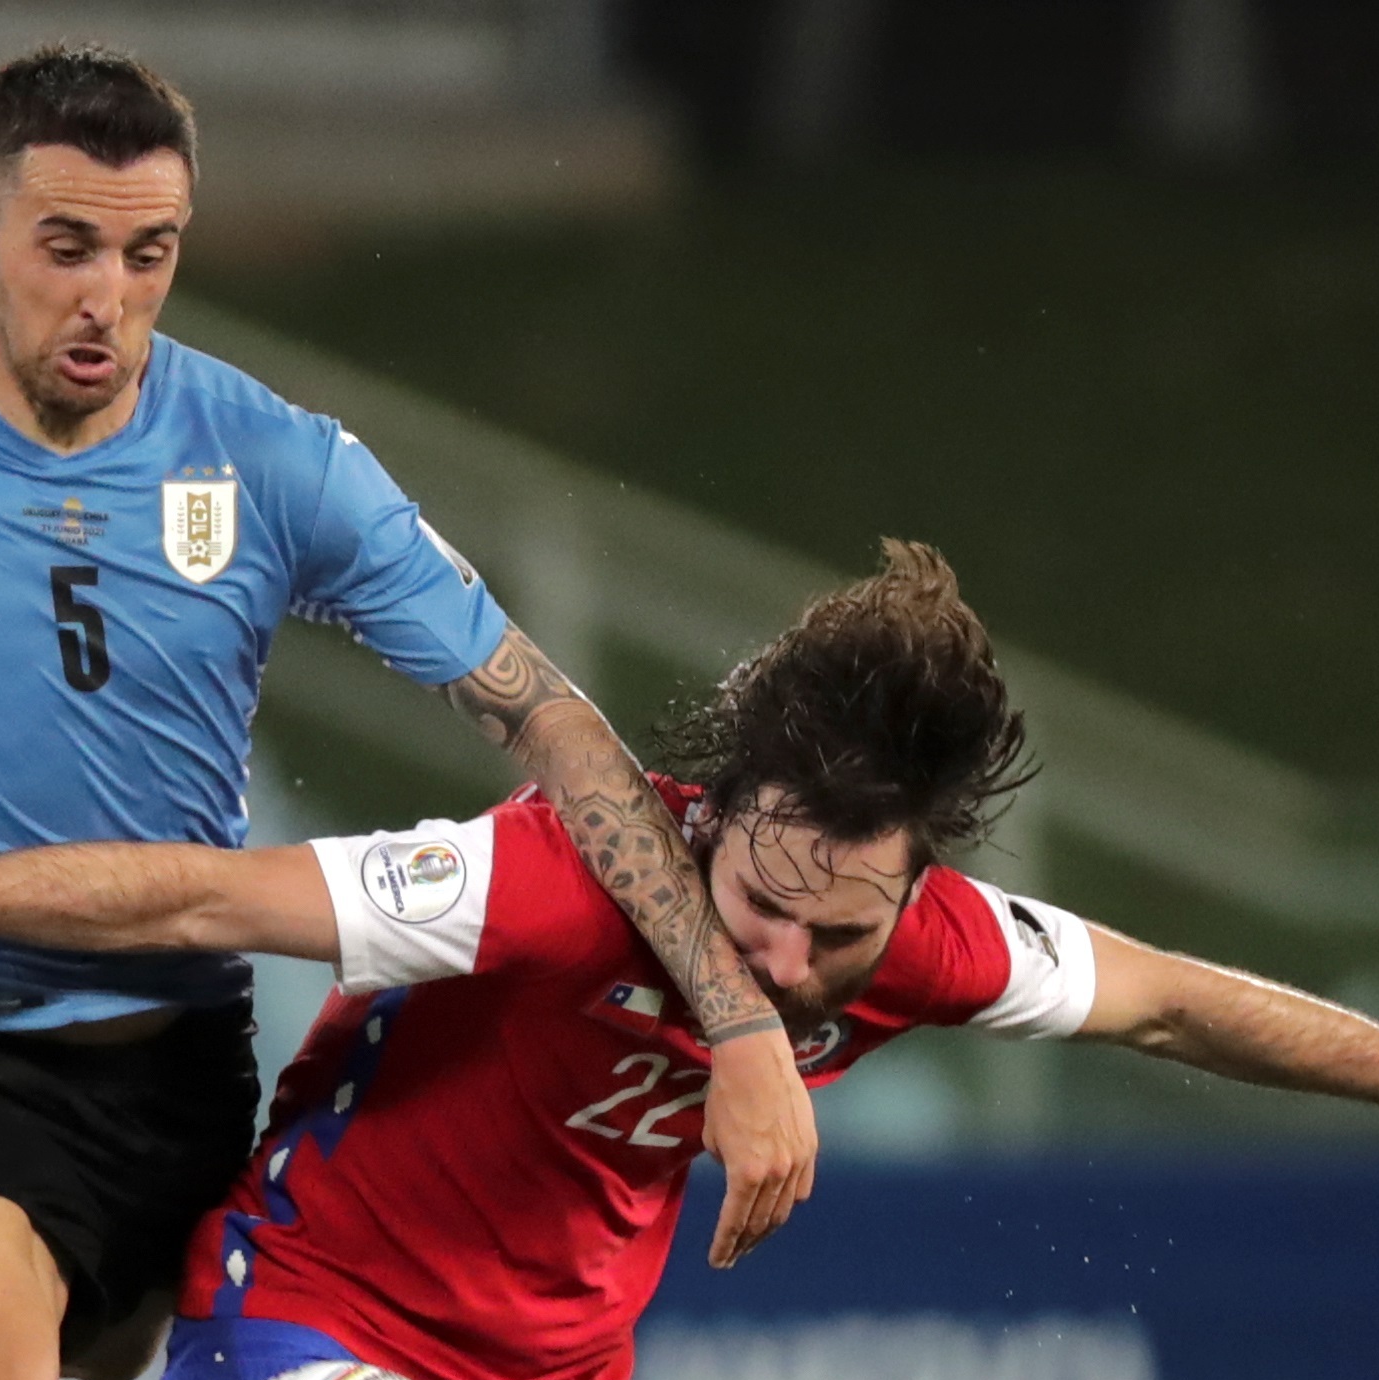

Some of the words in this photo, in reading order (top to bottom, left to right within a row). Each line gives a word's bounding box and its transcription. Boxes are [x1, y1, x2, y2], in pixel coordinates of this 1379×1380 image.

[191, 499, 208, 535] AUF
[49, 565, 111, 692] 5
[565, 1053, 711, 1148] 22
